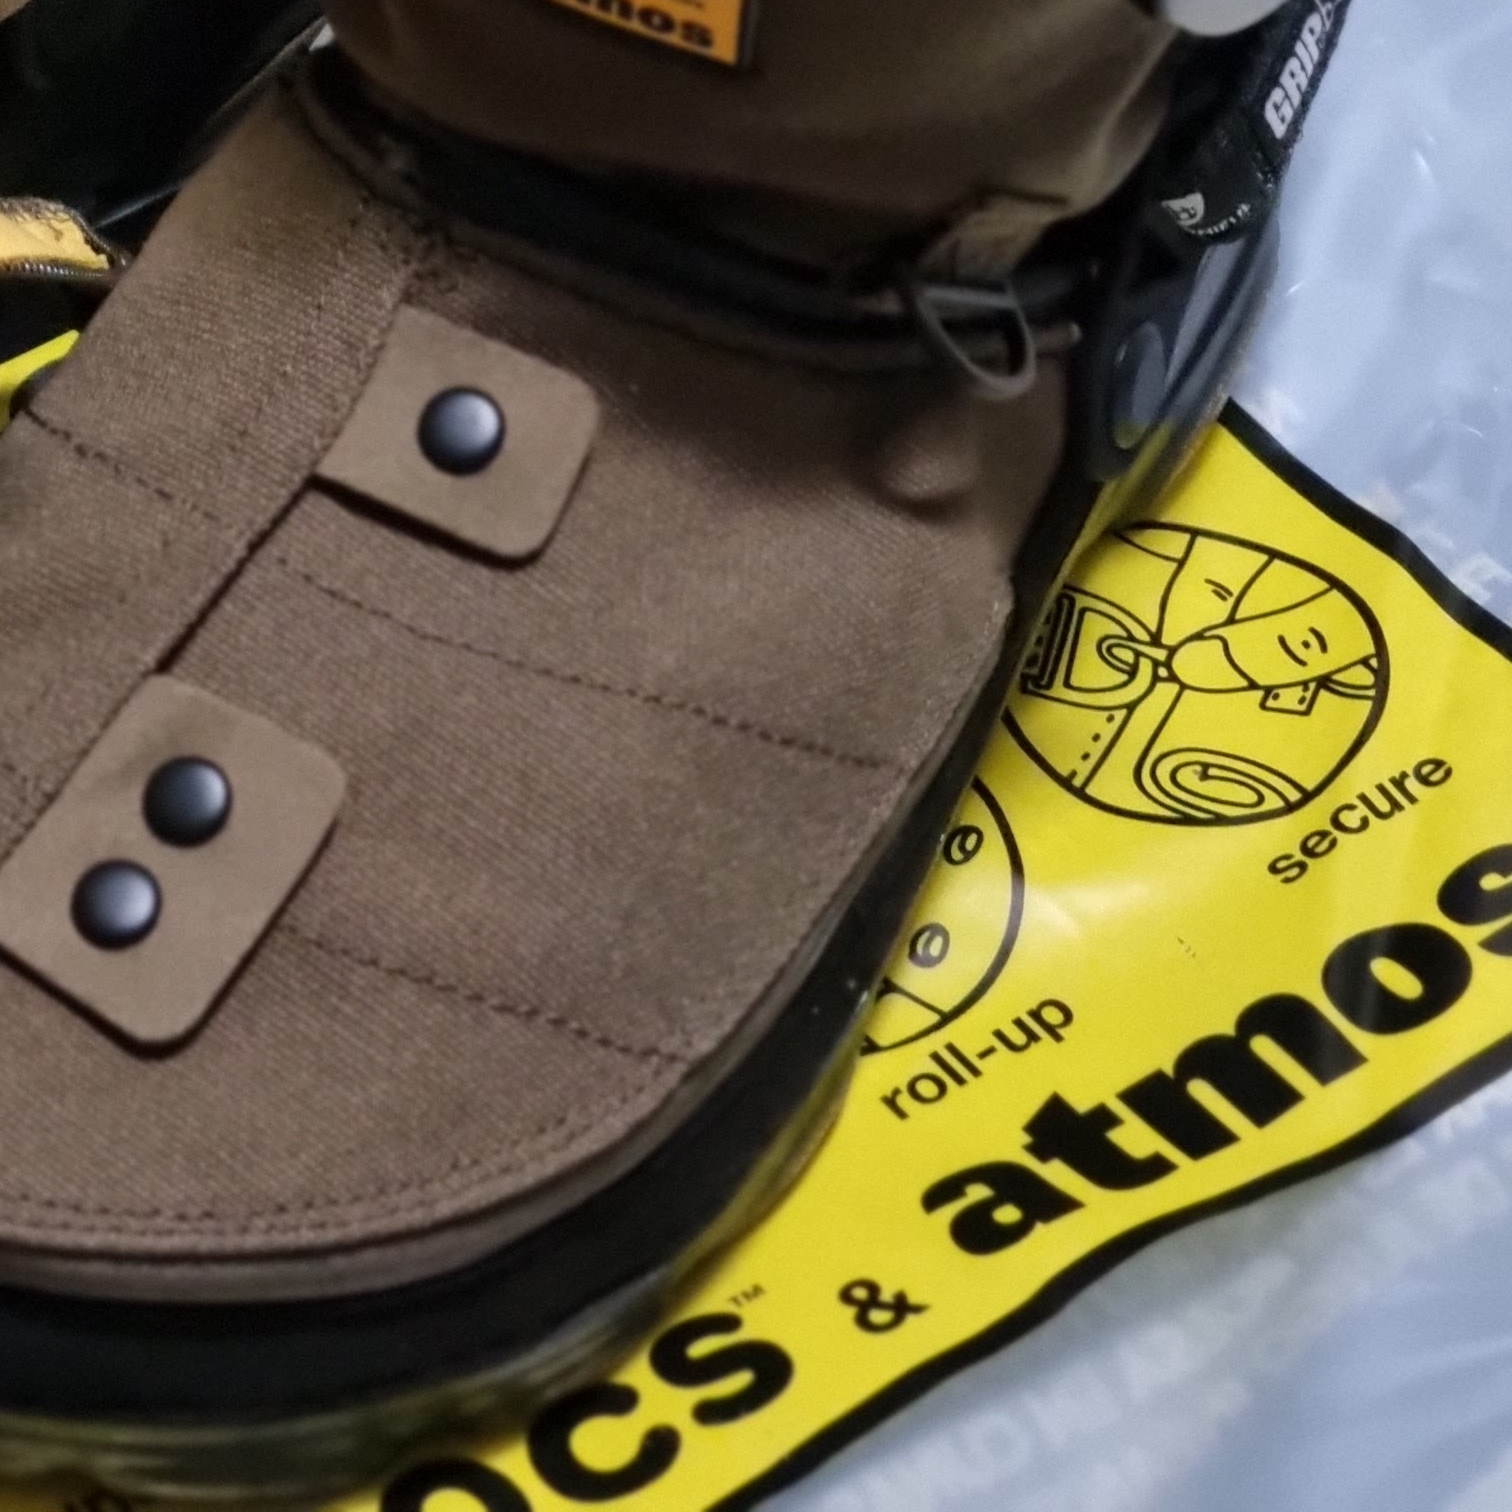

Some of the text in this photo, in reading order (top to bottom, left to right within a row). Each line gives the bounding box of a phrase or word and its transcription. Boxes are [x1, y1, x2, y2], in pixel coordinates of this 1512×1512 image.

[1264, 10, 1324, 140] GRIP
[1266, 757, 1454, 884] secure
[837, 1277, 931, 1335] &
[920, 843, 1512, 1256] atmos
[880, 998, 1075, 1121] roll-up
